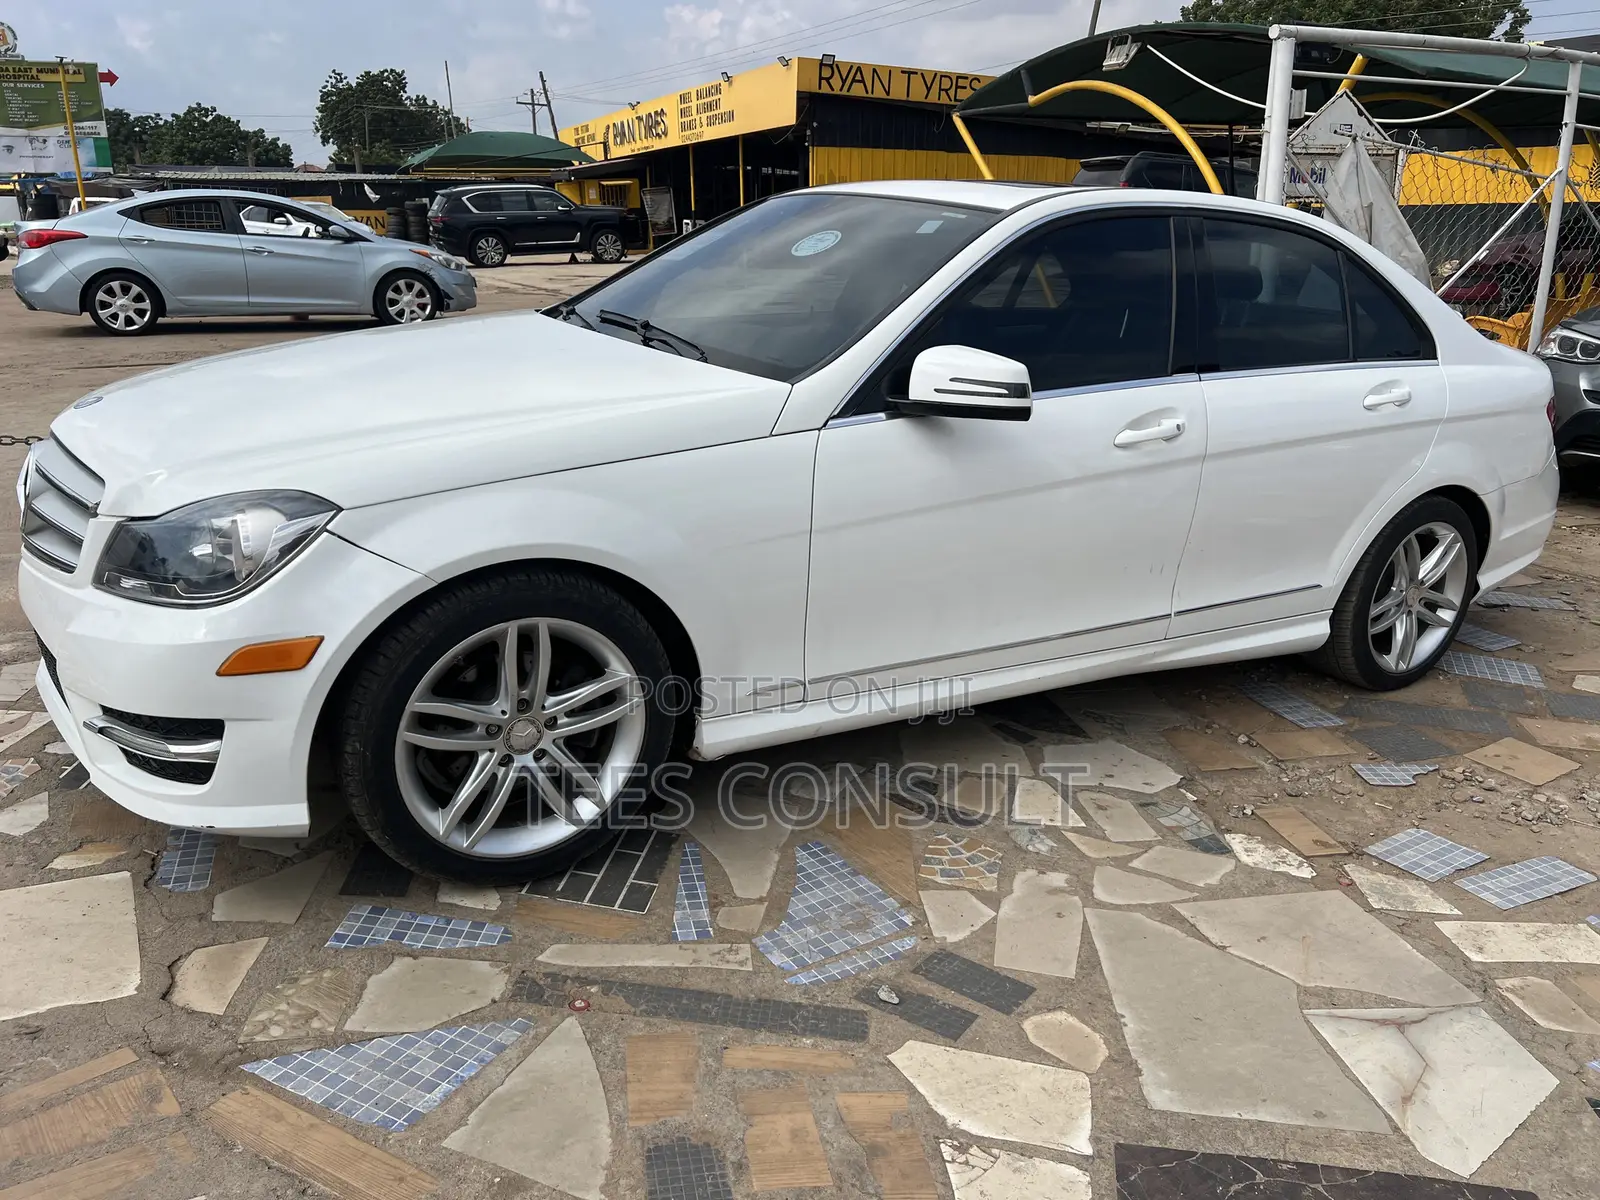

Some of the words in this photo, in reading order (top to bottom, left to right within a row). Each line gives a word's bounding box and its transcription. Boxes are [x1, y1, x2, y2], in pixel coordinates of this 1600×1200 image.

[818, 62, 892, 97] RYAN
[696, 82, 722, 101] BALANCING
[696, 98, 721, 116] ALIGNMENT
[706, 109, 735, 127] SUSPENSION
[613, 117, 637, 147] RYAN
[636, 109, 668, 141] TYRES
